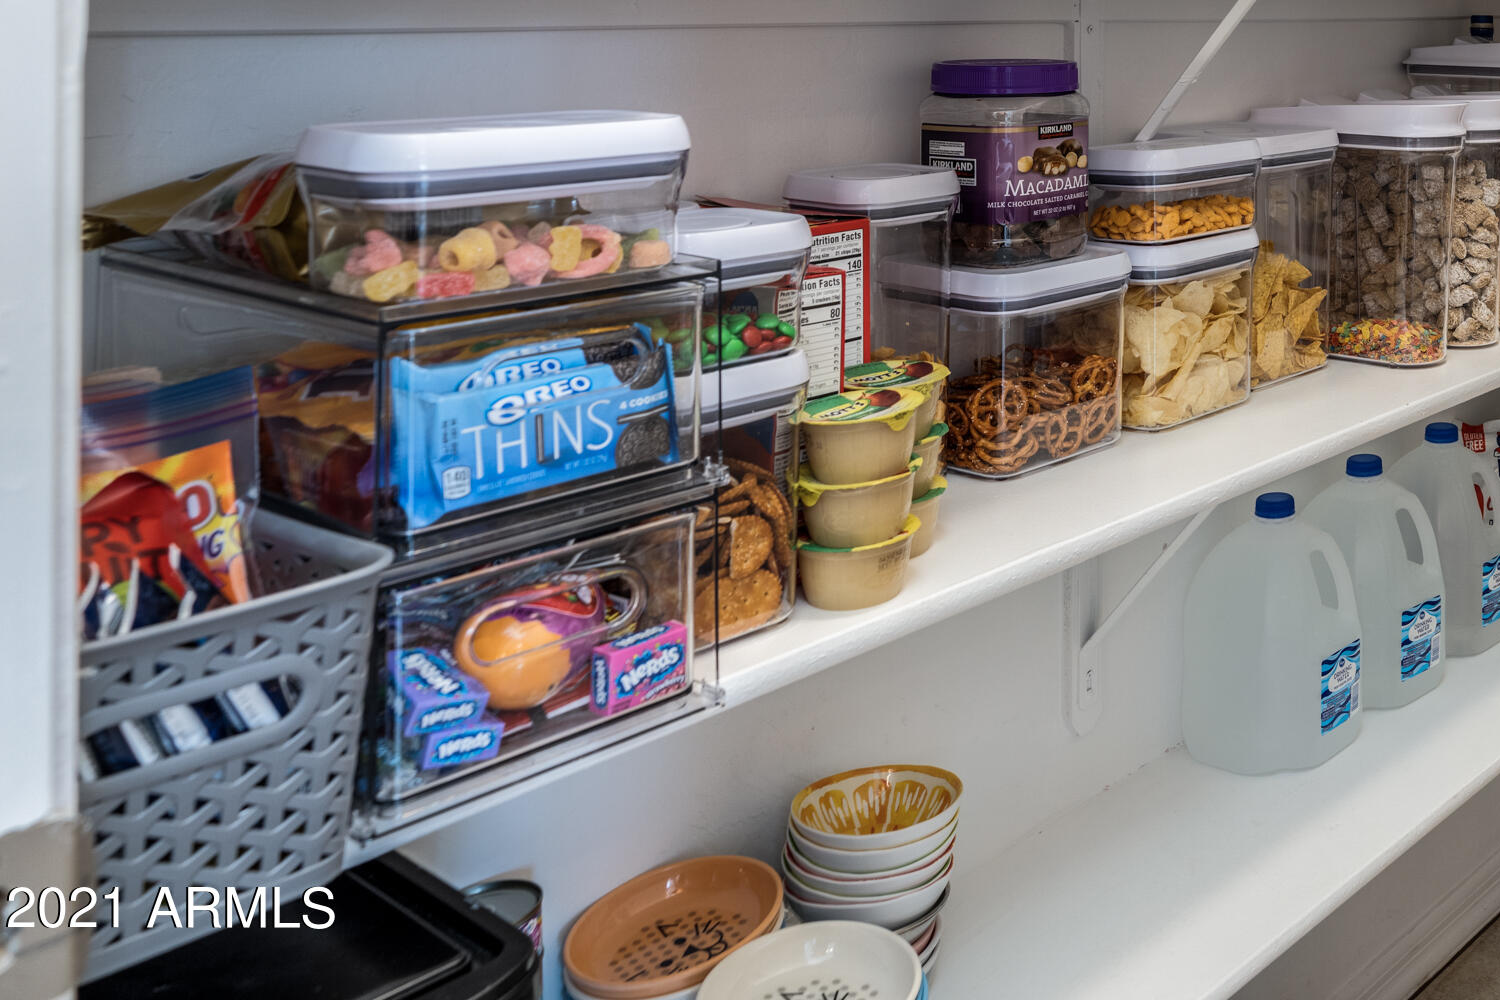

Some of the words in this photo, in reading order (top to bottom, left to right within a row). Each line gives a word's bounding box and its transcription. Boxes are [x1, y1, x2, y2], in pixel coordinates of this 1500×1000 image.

[1039, 122, 1073, 136] KIRKLAND
[932, 158, 974, 174] KIRKLAND
[1003, 174, 1088, 198] MACADAMI
[987, 200, 1006, 209] MILK
[1007, 197, 1043, 208] CHOCOLATE
[1044, 194, 1064, 205] SALTED
[841, 231, 862, 242] Facts
[846, 259, 863, 271] 140
[818, 276, 841, 289] Facts
[829, 307, 841, 319] 80
[487, 376, 592, 426] OREO
[461, 399, 614, 480] THINS
[1465, 440, 1485, 451] FREE
